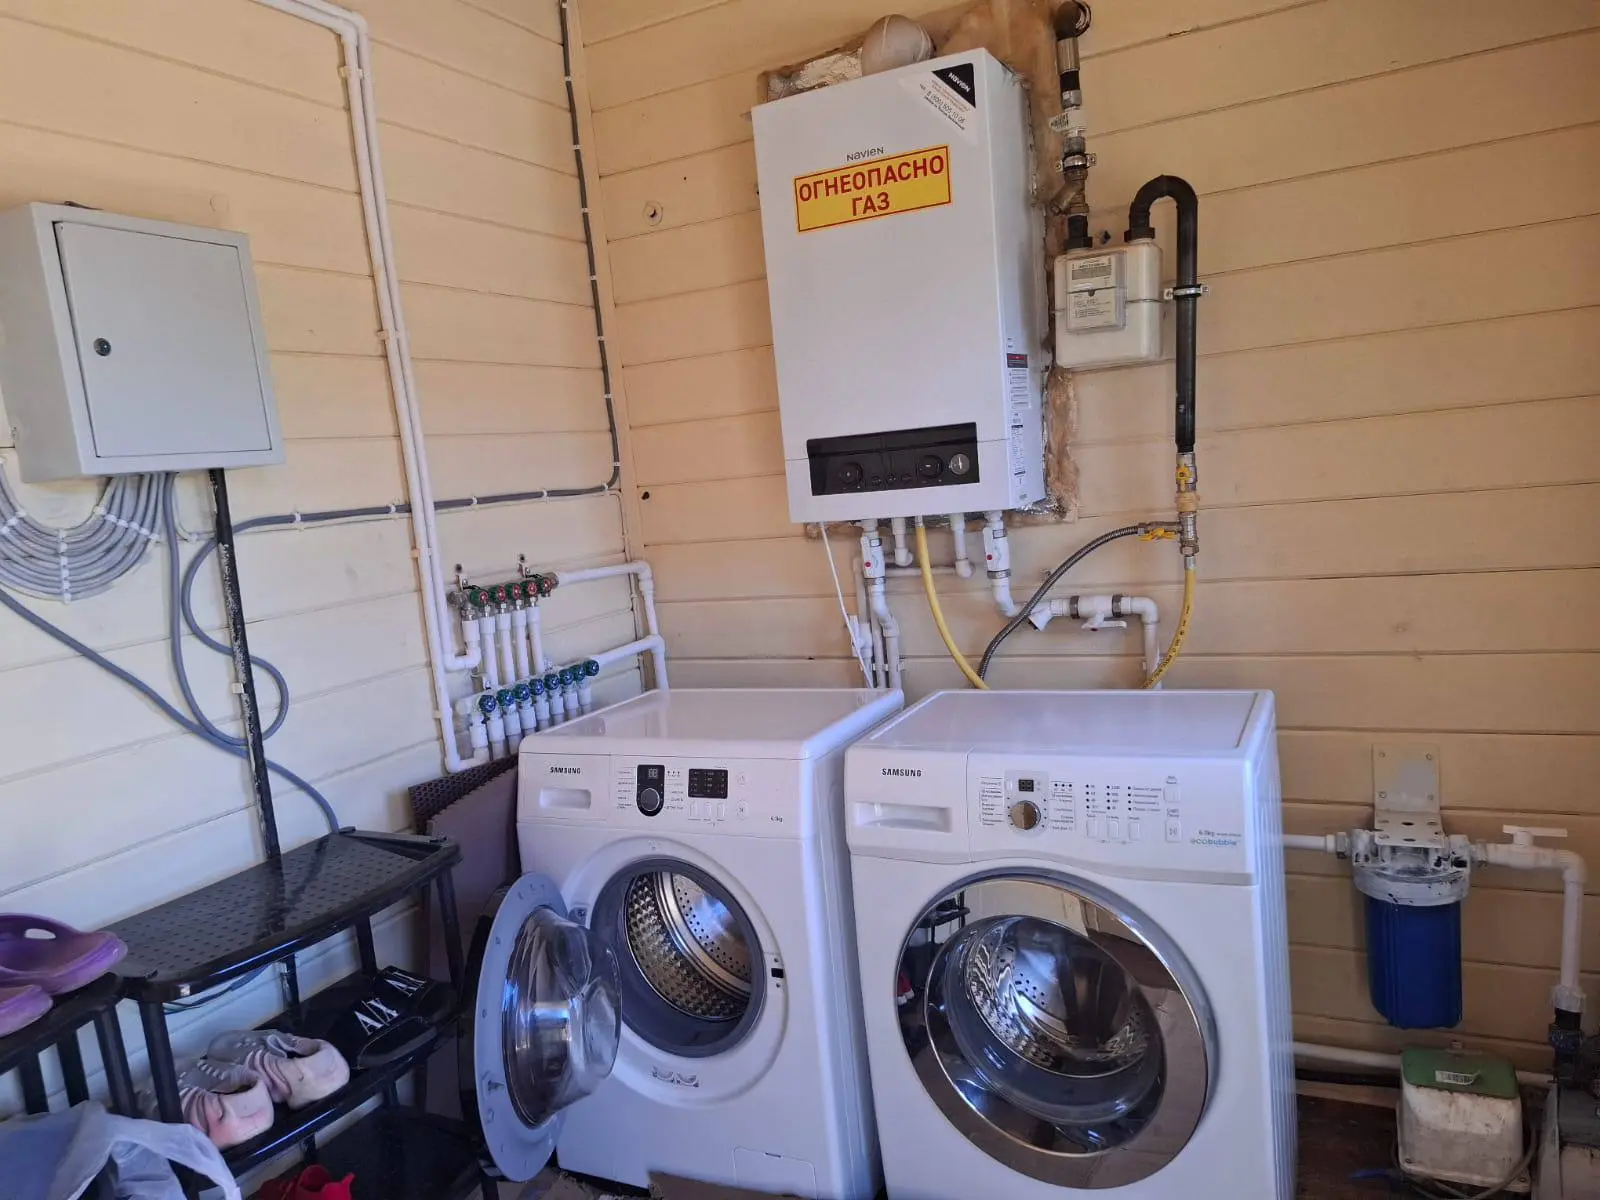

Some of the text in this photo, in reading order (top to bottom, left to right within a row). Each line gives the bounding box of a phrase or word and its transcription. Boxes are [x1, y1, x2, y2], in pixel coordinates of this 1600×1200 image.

[799, 155, 944, 202] ОГНЕОПАСНО
[852, 191, 890, 216] ГАЗ
[550, 766, 581, 774] SAMSUNG
[881, 768, 922, 777] SAMSUNG
